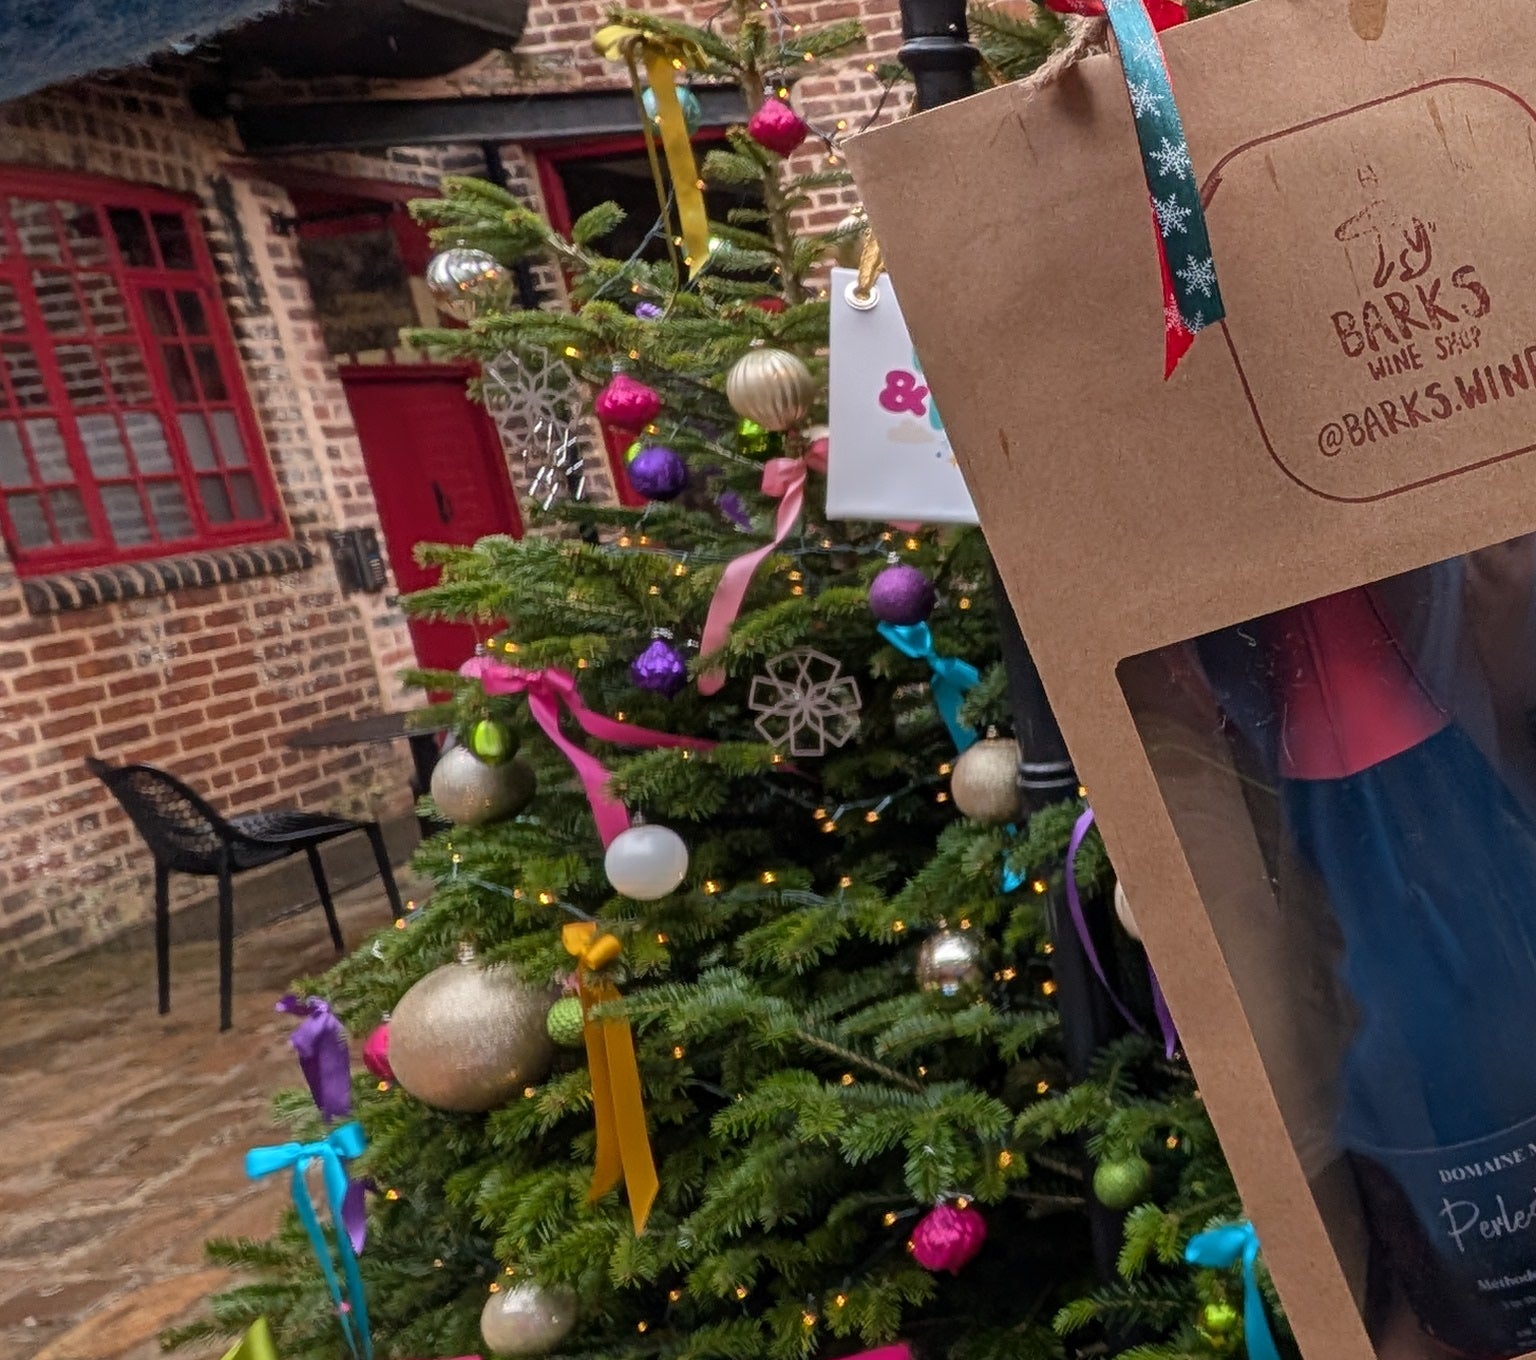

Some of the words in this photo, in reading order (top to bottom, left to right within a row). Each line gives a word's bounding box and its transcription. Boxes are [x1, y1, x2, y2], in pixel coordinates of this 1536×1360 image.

[1330, 265, 1493, 358] BARKS
[1367, 343, 1424, 381] WINE
[1434, 325, 1482, 361] SHOP
[1438, 1147, 1526, 1184] DOMAINE
